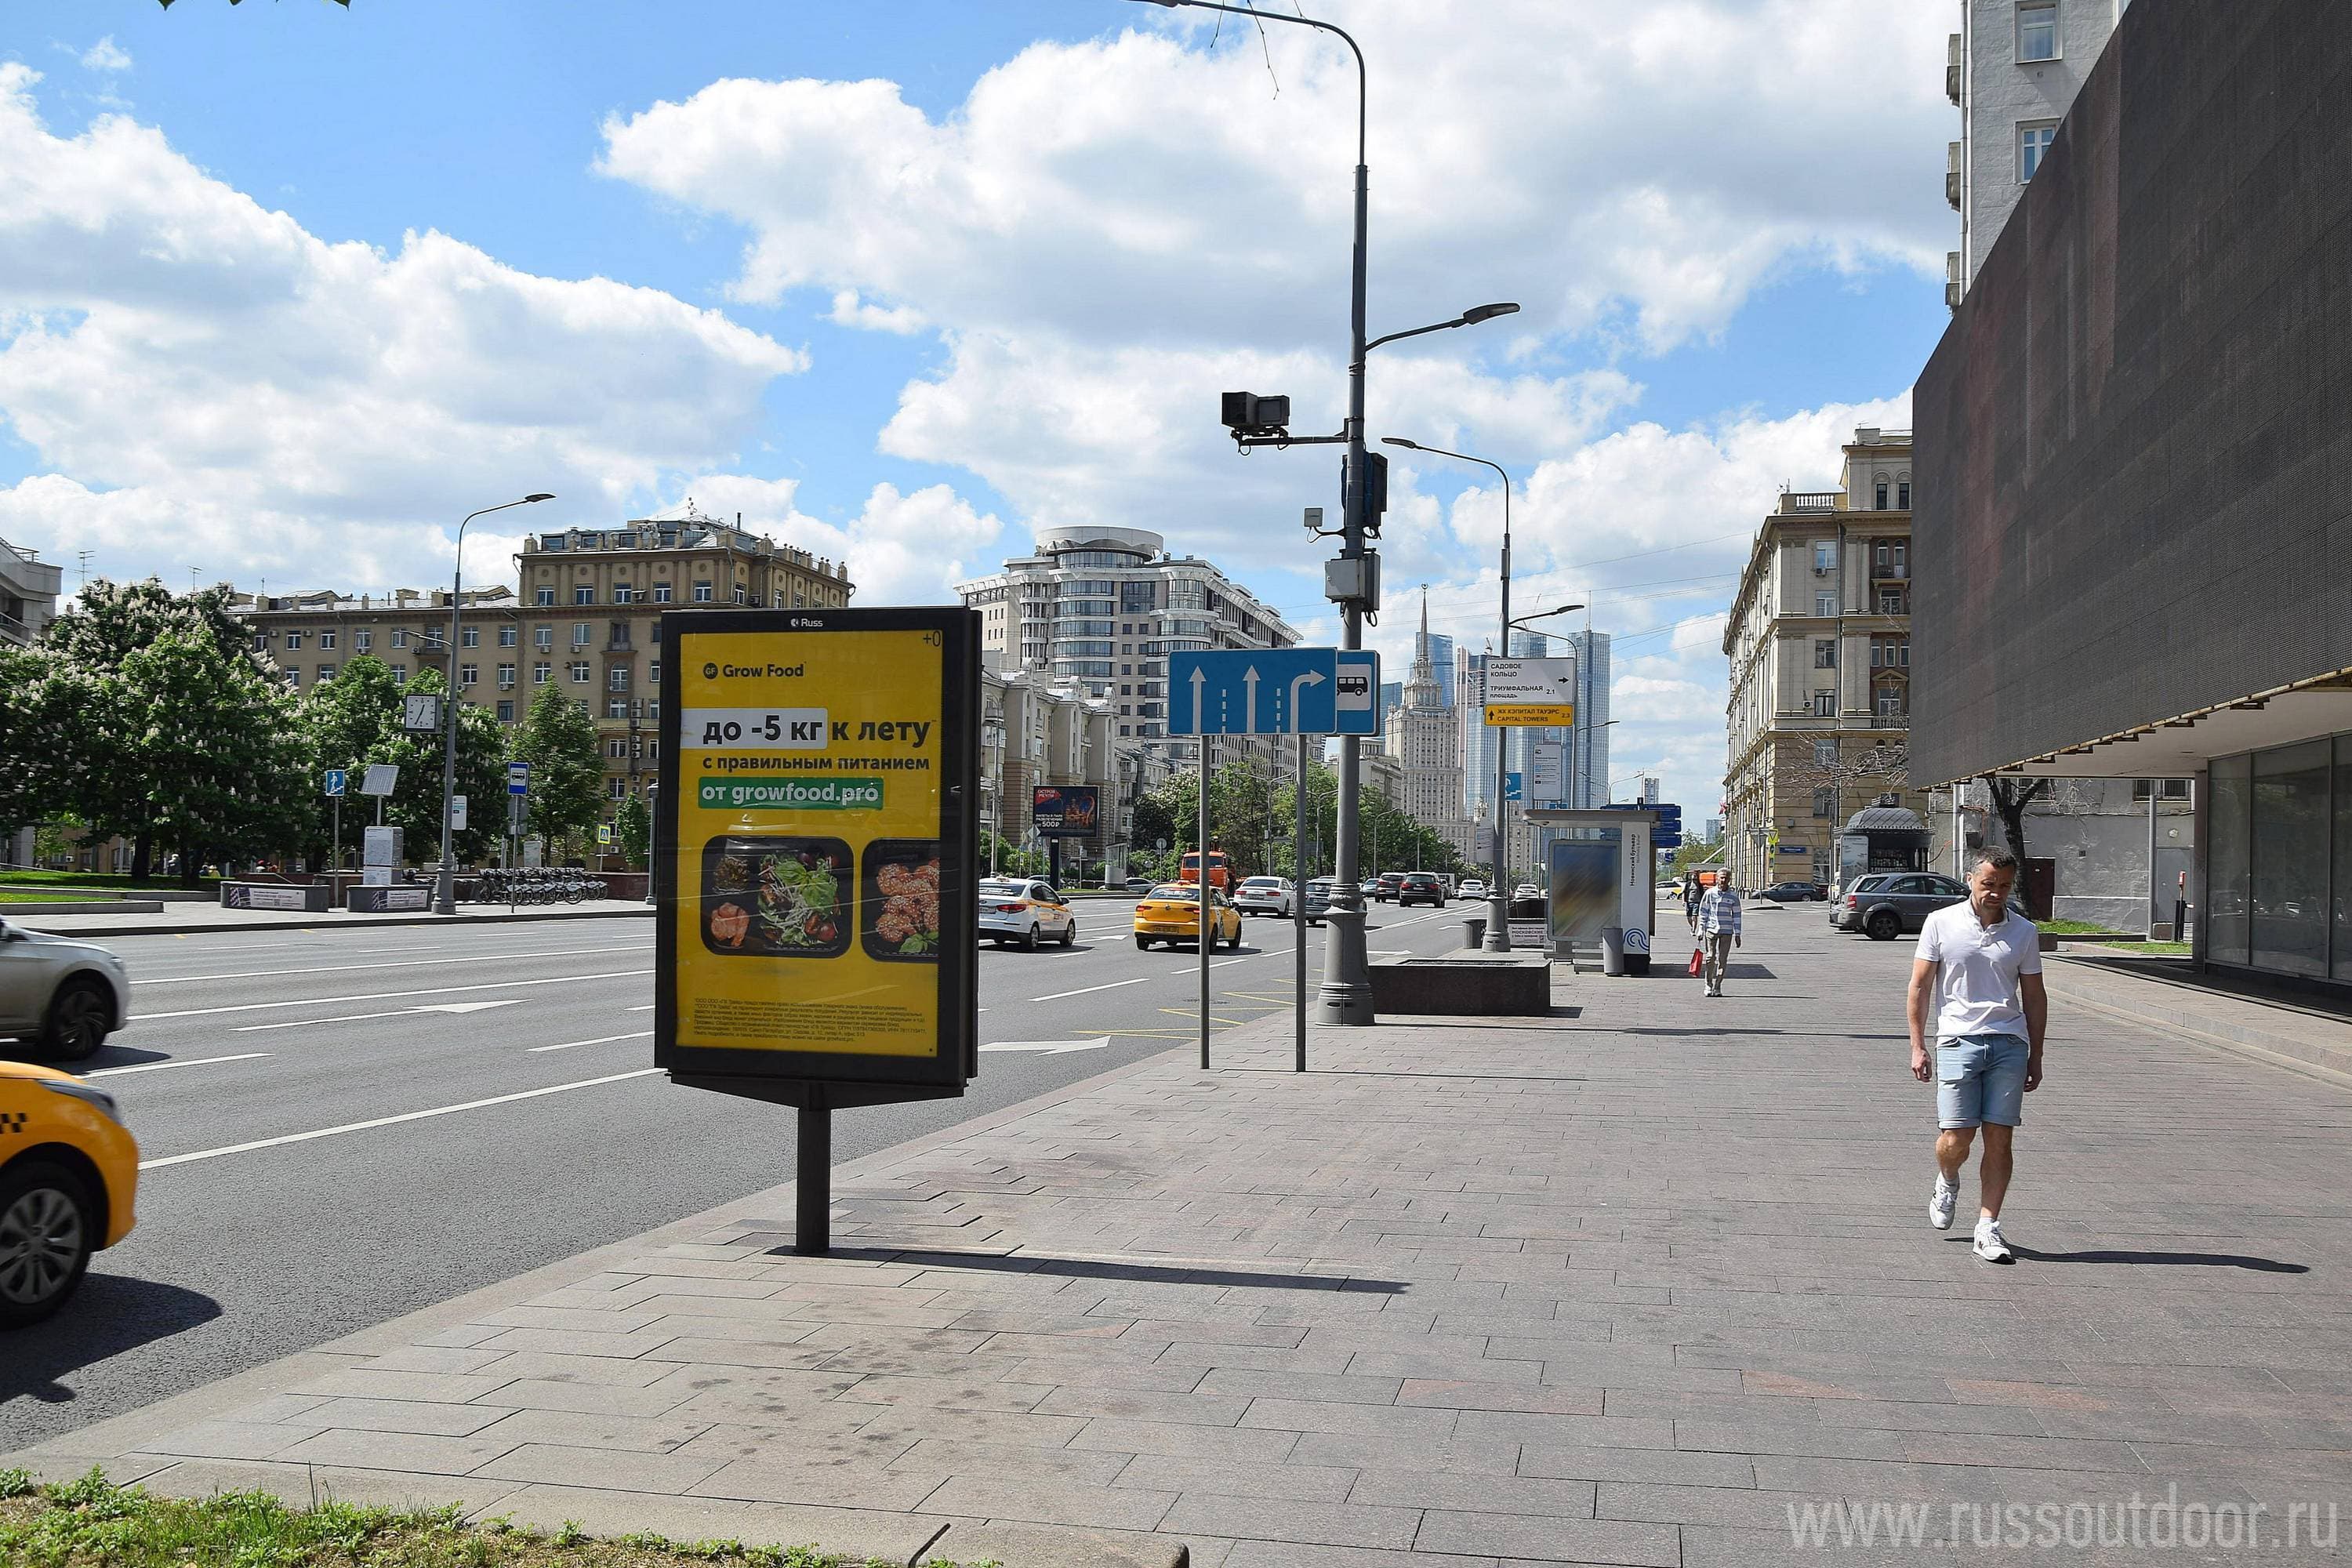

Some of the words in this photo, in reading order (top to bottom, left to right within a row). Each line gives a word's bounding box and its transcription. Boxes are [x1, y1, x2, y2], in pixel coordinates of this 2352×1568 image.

[800, 618, 823, 627] Russ
[723, 664, 762, 678] Grow
[768, 662, 805, 677] Food
[702, 721, 742, 745] до
[751, 715, 782, 741] -5
[791, 722, 823, 741] кг
[832, 721, 849, 741] к
[702, 757, 712, 769] с
[717, 757, 833, 772] правильным
[838, 757, 930, 770] питанием
[702, 786, 726, 800] от
[731, 783, 879, 804] growfood.pro
